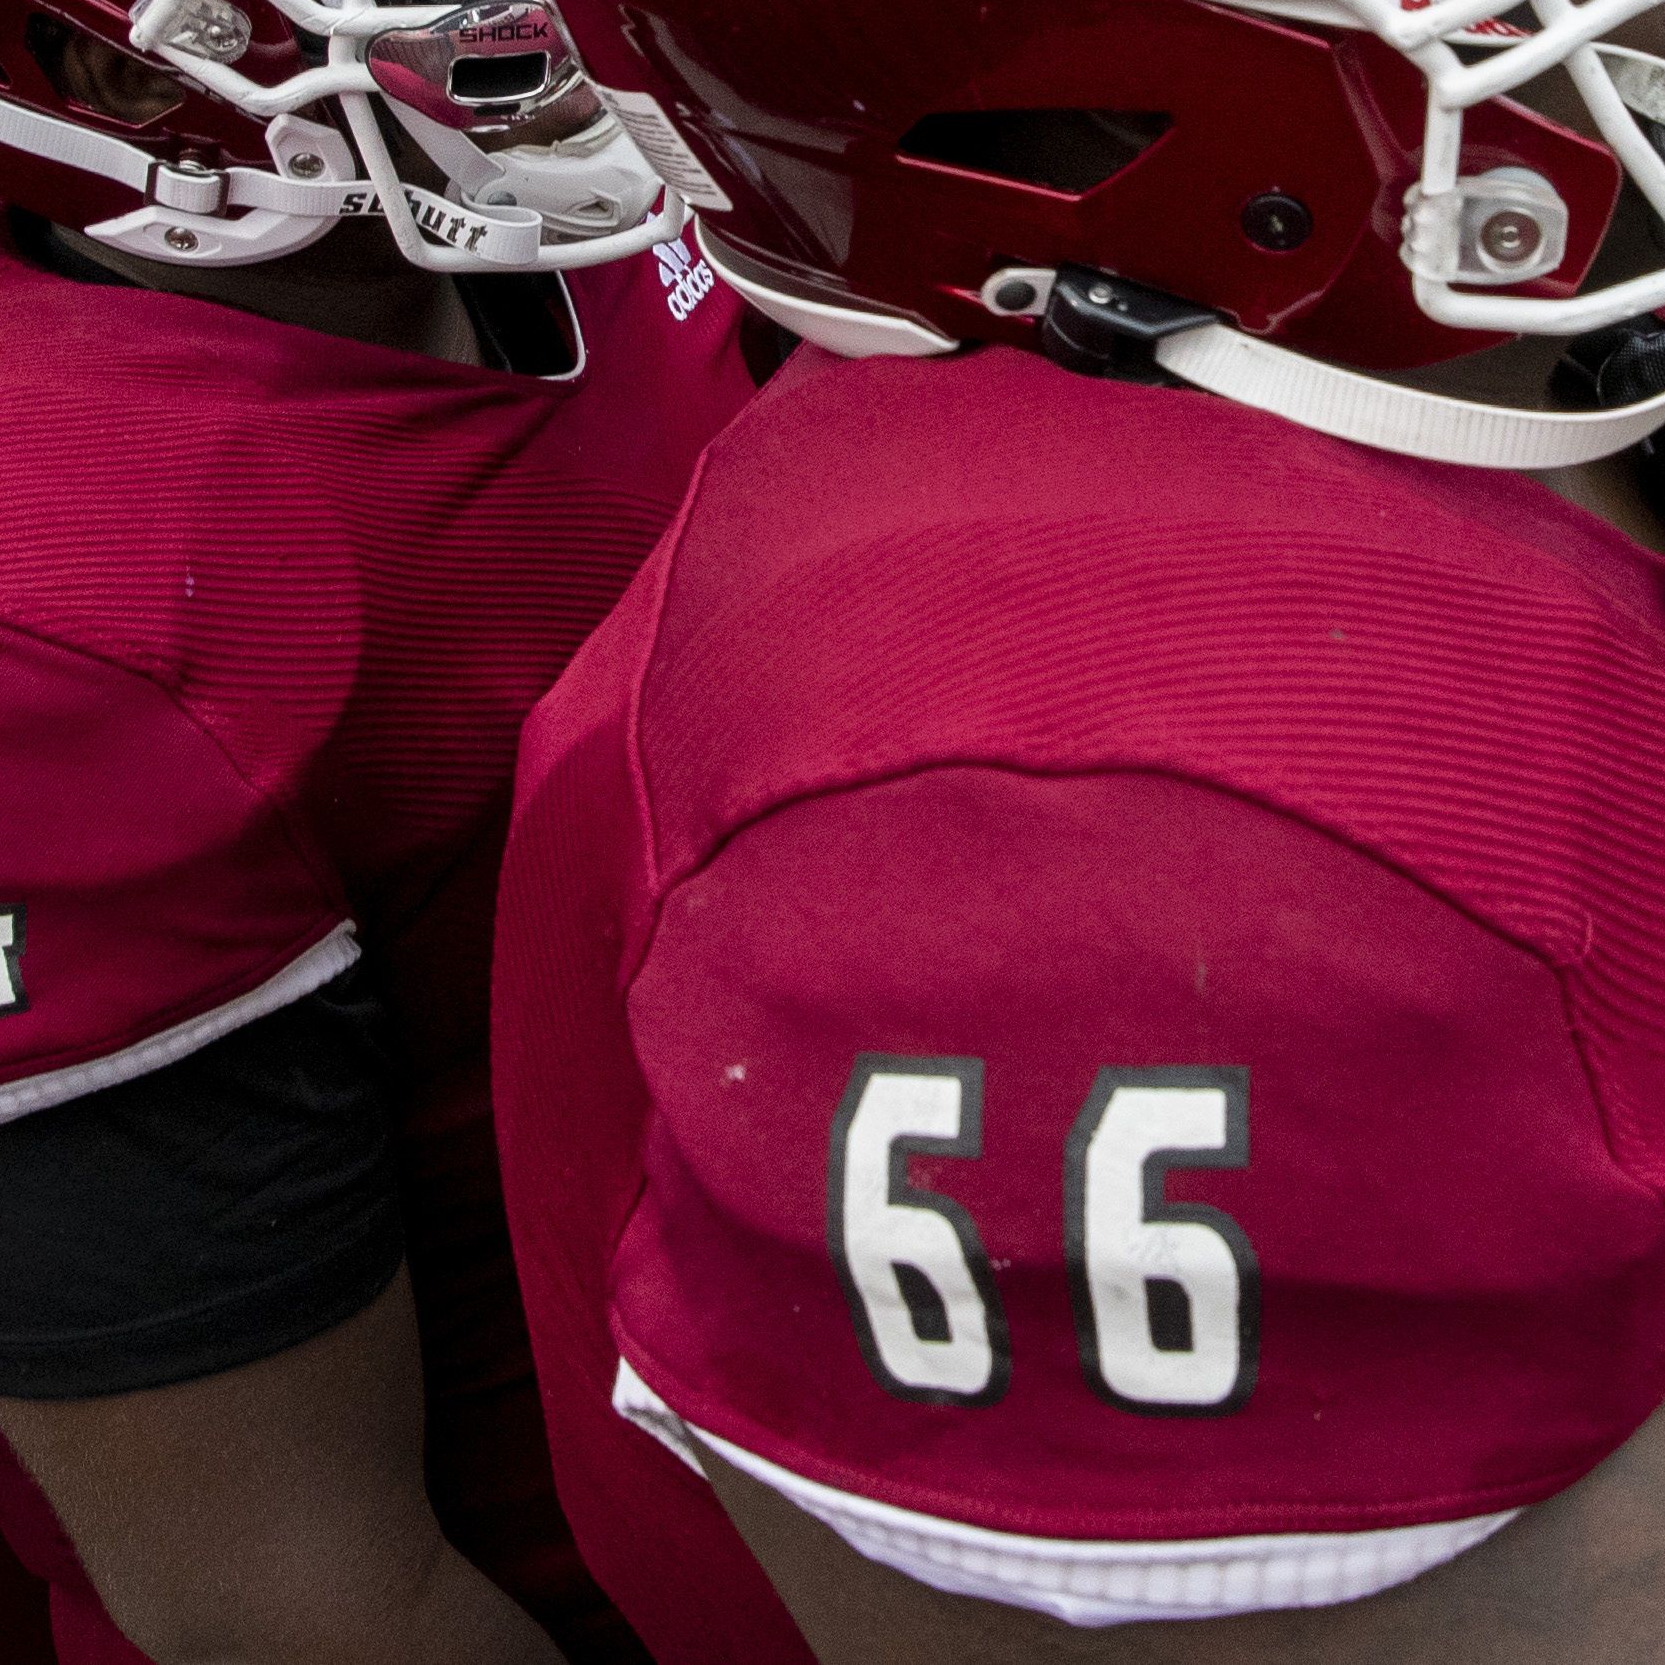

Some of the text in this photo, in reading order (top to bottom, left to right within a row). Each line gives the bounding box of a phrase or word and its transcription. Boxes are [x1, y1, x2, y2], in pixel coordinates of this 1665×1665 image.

[458, 21, 548, 44] SHOCK
[667, 258, 715, 322] adidas
[826, 1050, 1262, 1419] 66
